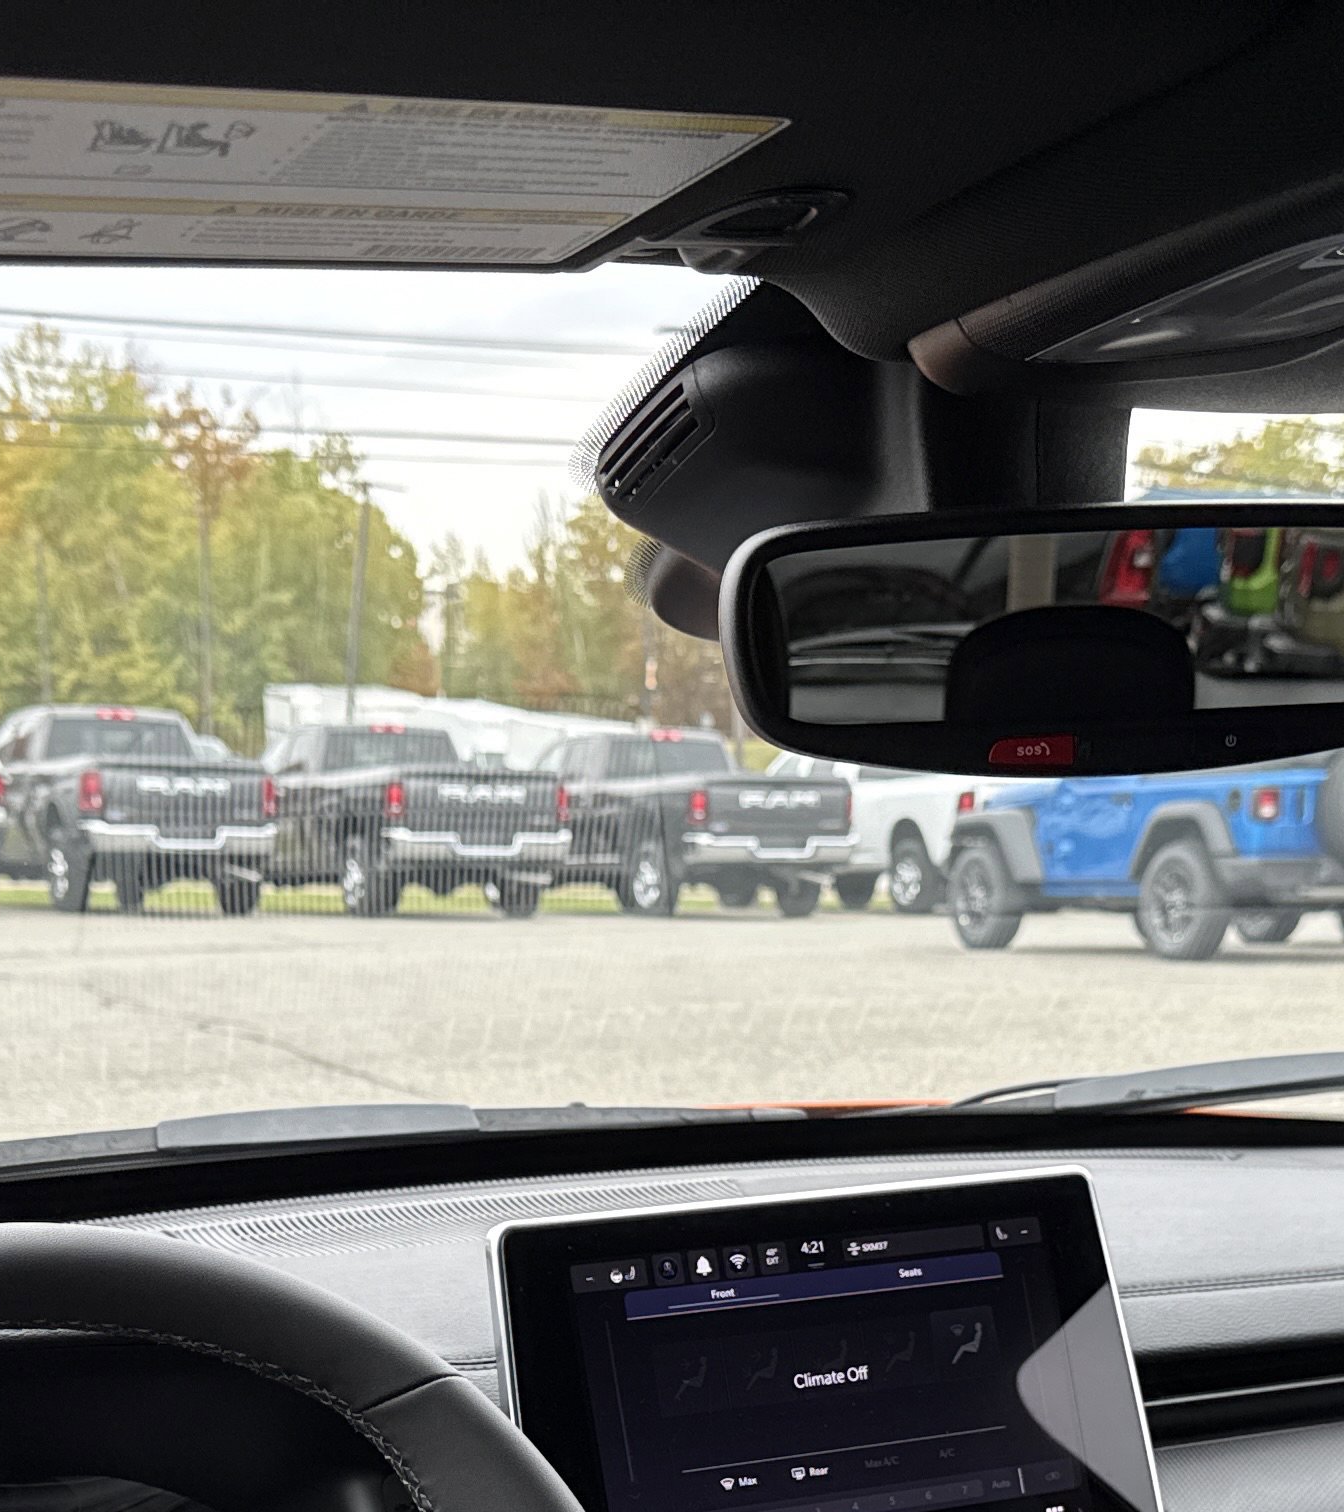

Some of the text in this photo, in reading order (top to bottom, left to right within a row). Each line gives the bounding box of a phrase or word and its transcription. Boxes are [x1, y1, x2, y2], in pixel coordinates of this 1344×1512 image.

[388, 101, 605, 124] MISE EN GARDE
[257, 205, 465, 221] MISE EN GARDE
[1016, 745, 1043, 757] SOS
[136, 775, 231, 796] RAM
[437, 783, 527, 804] RAM
[738, 790, 821, 809] RAM
[800, 1240, 825, 1255] 4:21
[898, 1267, 923, 1279] Seats
[710, 1286, 735, 1300] Front
[793, 1364, 869, 1390] Climate Off
[808, 1465, 830, 1478] Rear
[738, 1475, 758, 1489] Max
